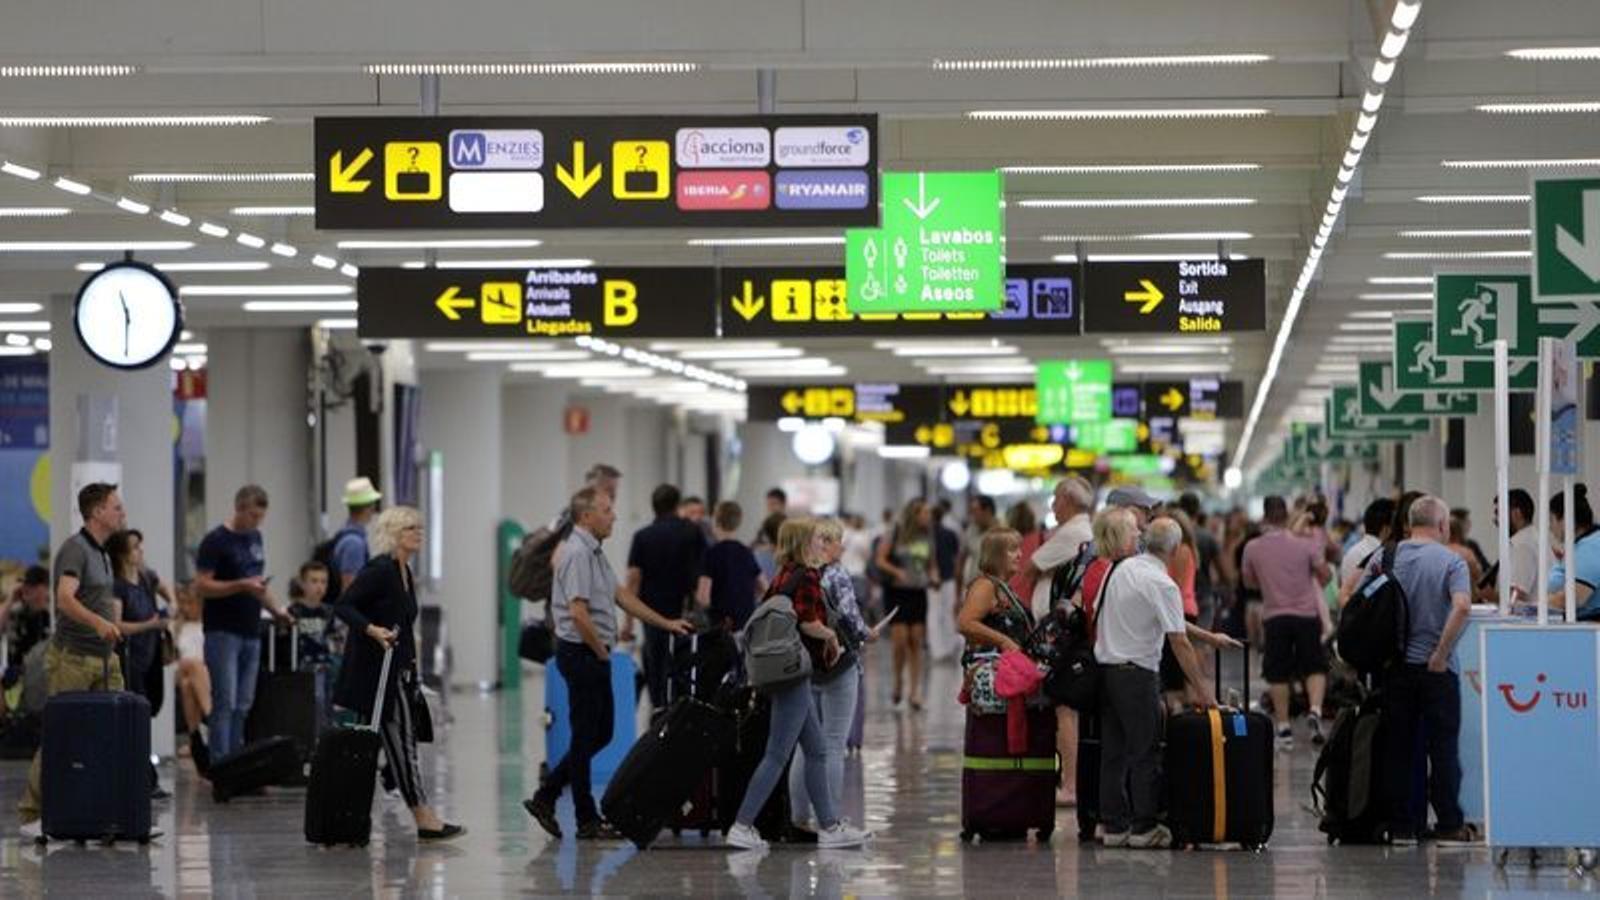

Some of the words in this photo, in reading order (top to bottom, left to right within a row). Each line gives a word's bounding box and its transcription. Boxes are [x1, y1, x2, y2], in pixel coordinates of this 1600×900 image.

[456, 138, 541, 162] MENZIES
[701, 138, 764, 155] acciona
[779, 142, 851, 158] groundforce
[684, 184, 729, 196] IBERIA
[789, 184, 866, 197] RYANAIR
[920, 228, 993, 244] Lavabos
[921, 248, 966, 262] Toilets
[921, 266, 979, 281] Toiletten
[1178, 262, 1228, 276] Sortida
[527, 271, 597, 284] Arribades
[526, 287, 571, 300] Arrivals
[921, 286, 975, 301] Aseos
[1178, 280, 1199, 294] Exit
[526, 303, 571, 317] Ankunft
[604, 280, 638, 326] B
[1178, 299, 1224, 315] Ausgang
[527, 320, 592, 334] Llegadas
[1178, 317, 1222, 331] Salida
[1552, 692, 1587, 708] TUI
